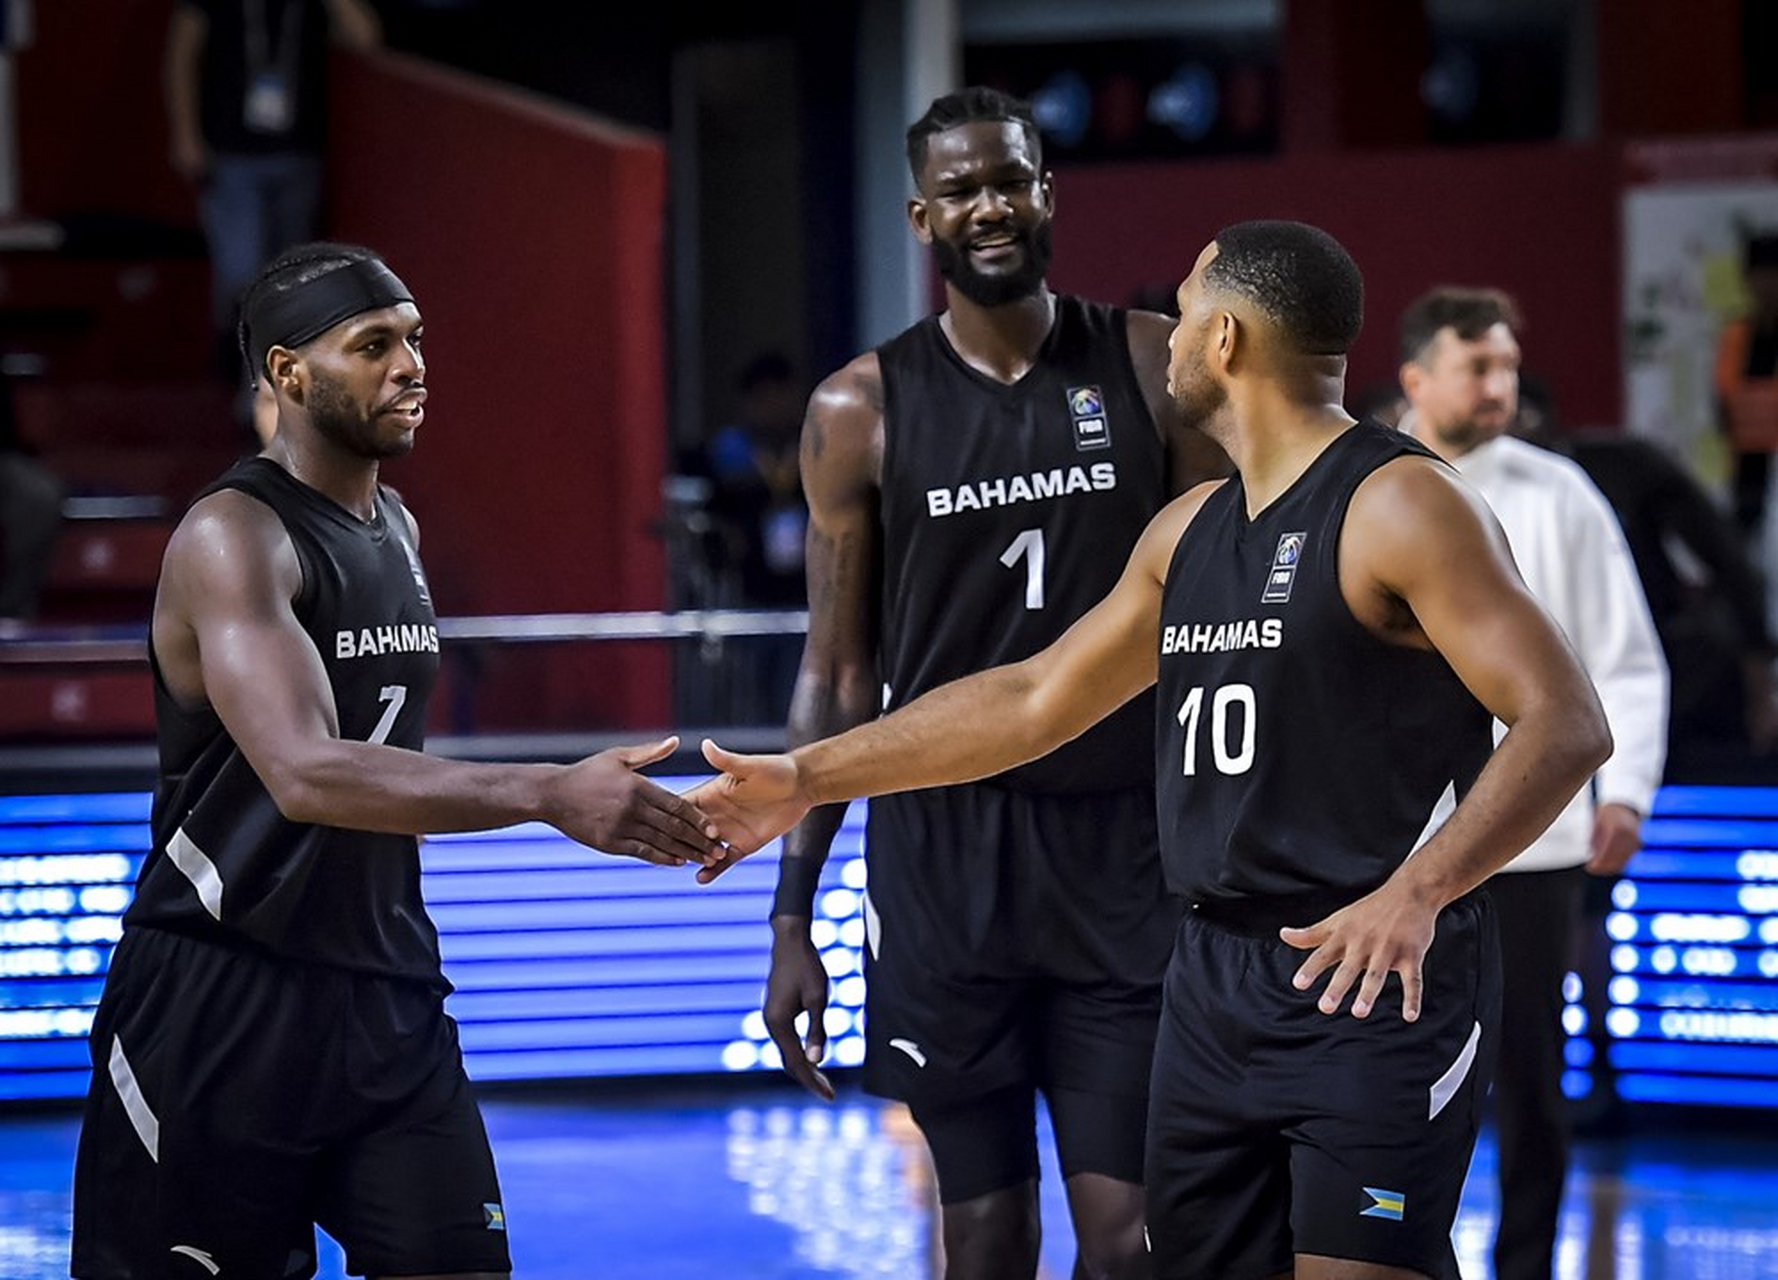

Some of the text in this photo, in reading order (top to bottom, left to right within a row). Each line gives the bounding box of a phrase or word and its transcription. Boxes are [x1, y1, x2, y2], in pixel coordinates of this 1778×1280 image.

[926, 463, 1116, 517] BAHAMAS
[1000, 528, 1044, 609] 1
[336, 624, 439, 658] BAHAMAS
[1161, 618, 1283, 654] BAHAMAS
[367, 685, 407, 744] 7
[1177, 683, 1256, 776] 10
